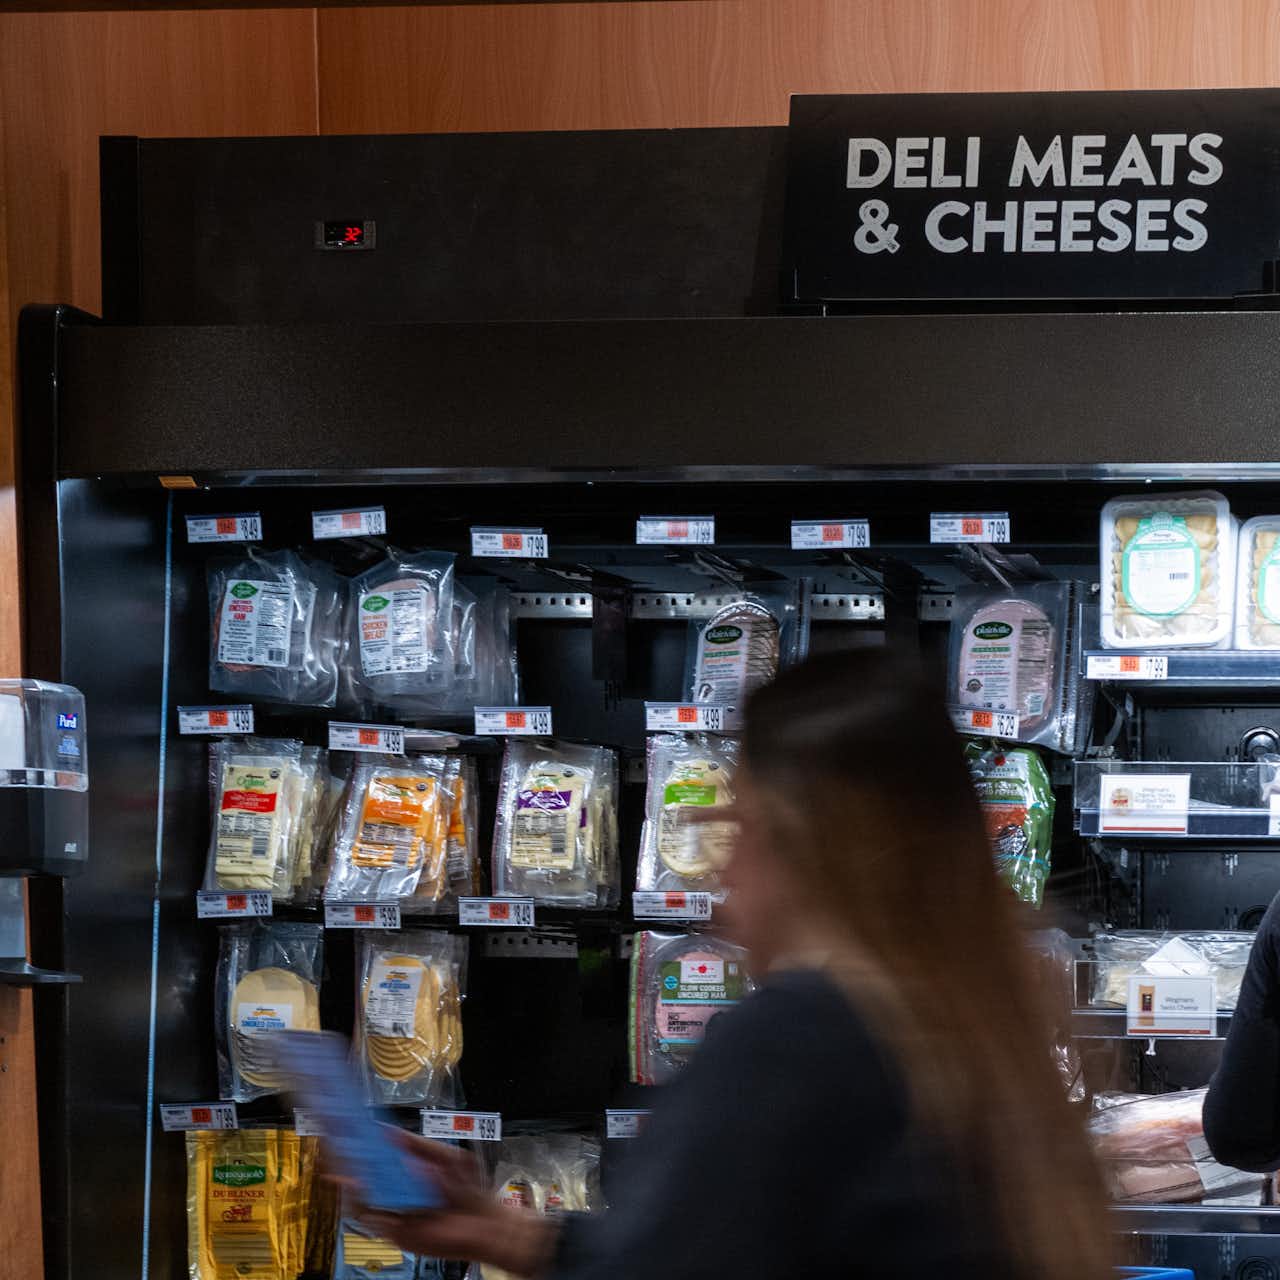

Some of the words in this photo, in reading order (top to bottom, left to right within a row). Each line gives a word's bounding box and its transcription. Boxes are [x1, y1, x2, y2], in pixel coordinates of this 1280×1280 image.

[846, 136, 980, 188] DELI
[1008, 133, 1223, 187] MEATS
[853, 199, 900, 253] &
[925, 199, 1208, 253] CHEESES
